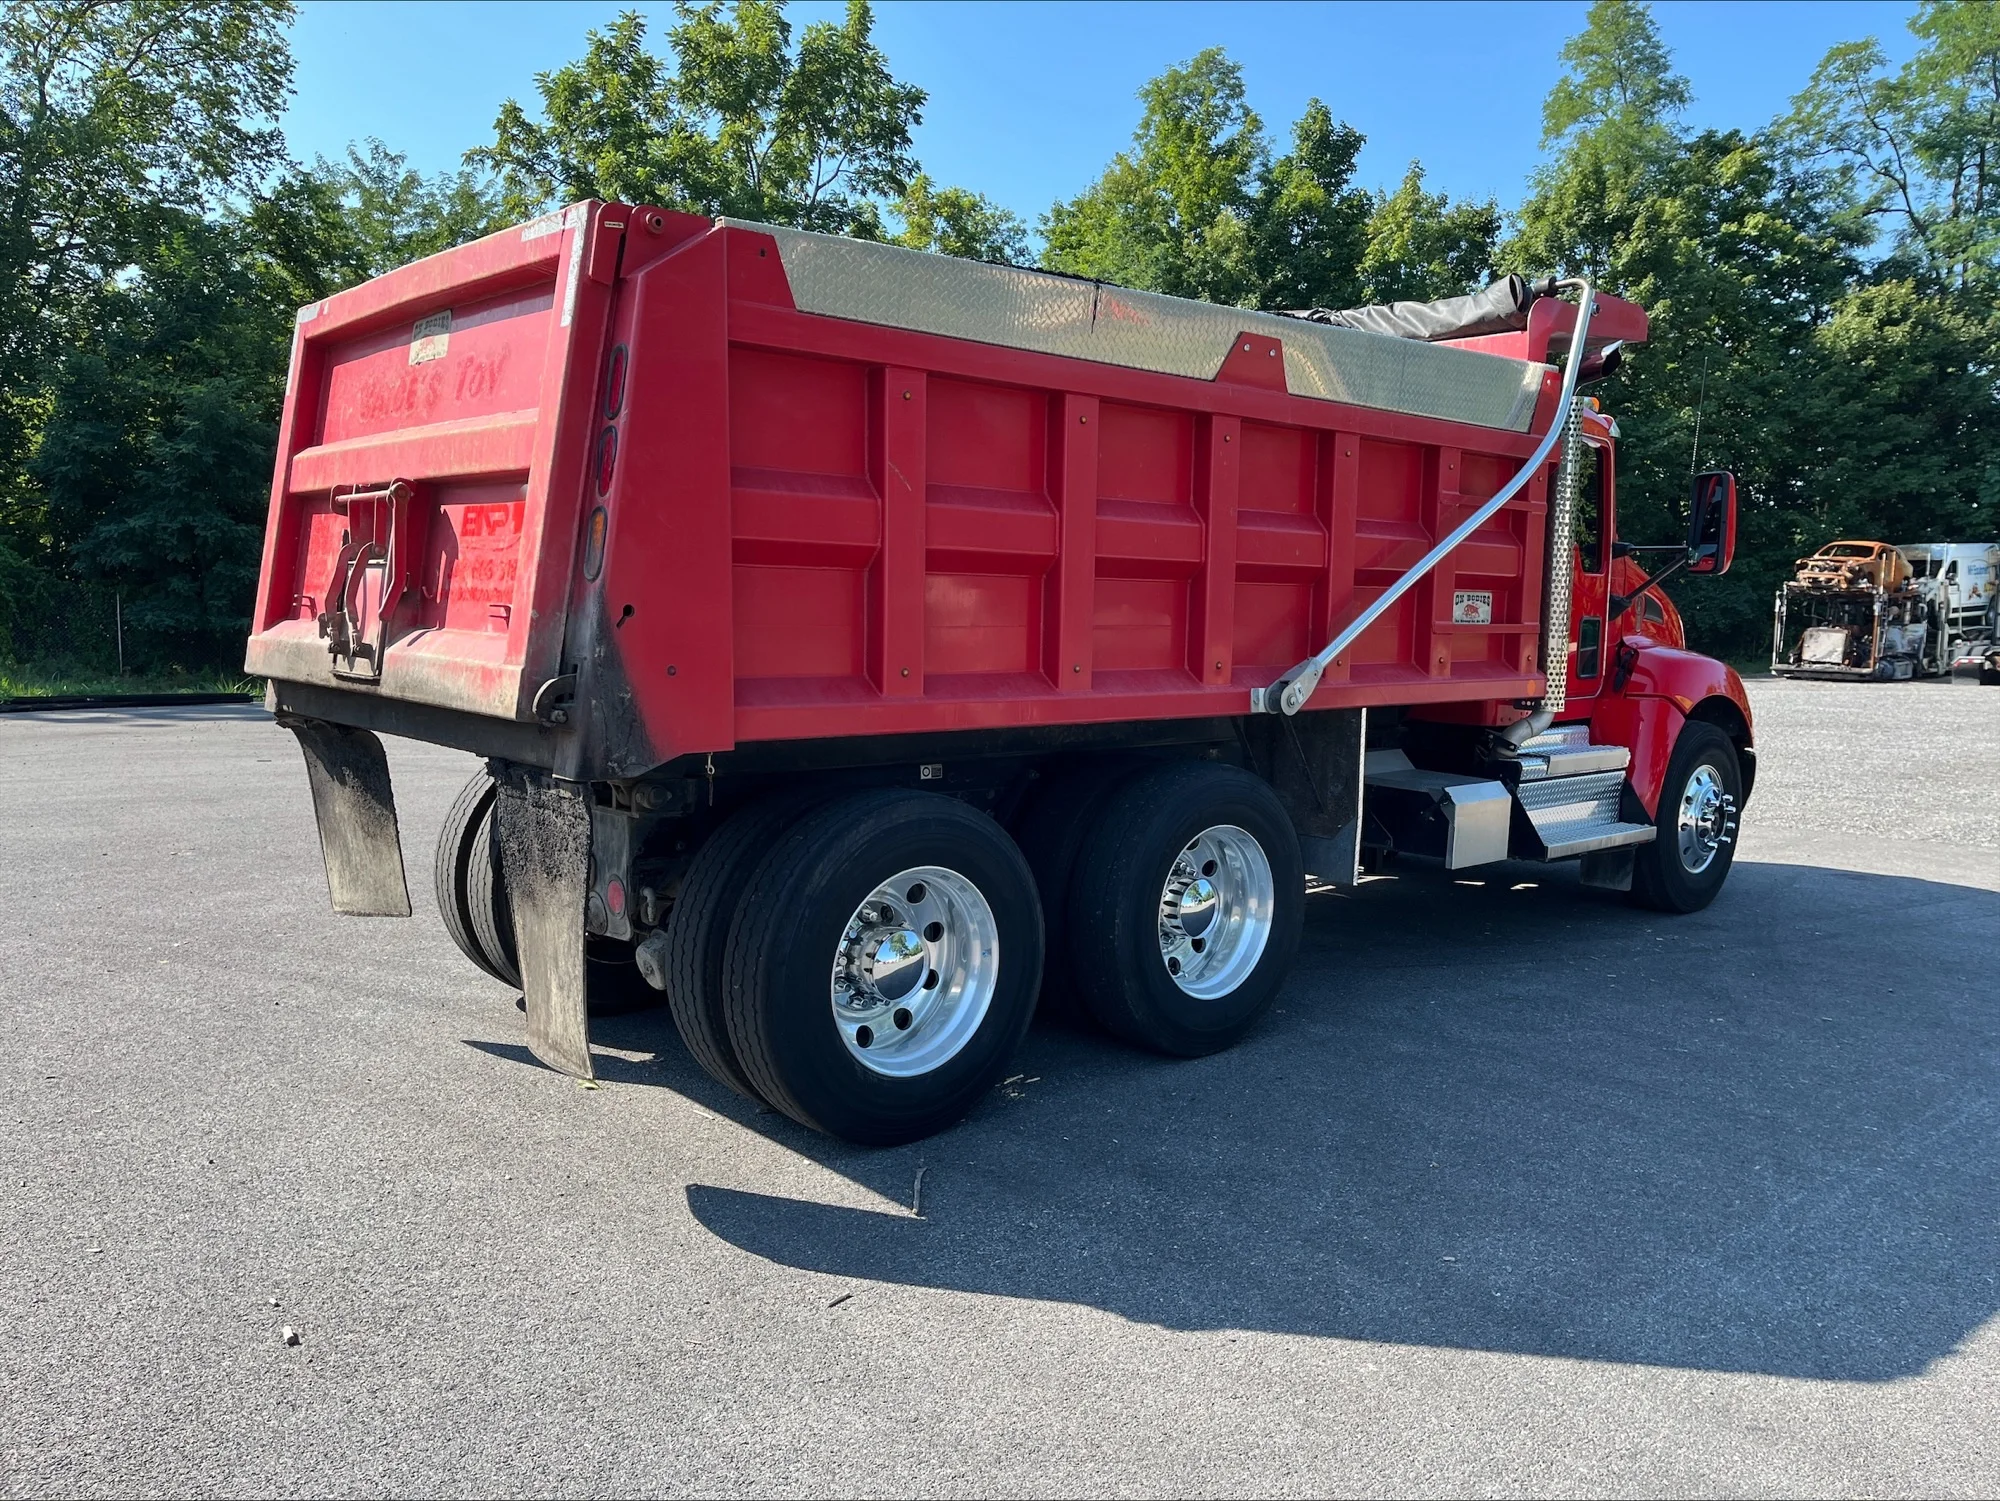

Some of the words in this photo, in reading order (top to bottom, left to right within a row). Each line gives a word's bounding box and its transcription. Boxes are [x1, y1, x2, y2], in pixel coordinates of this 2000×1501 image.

[424, 314, 450, 331] BODIES
[1455, 594, 1464, 605] OX
[1467, 594, 1490, 606] BODIES
